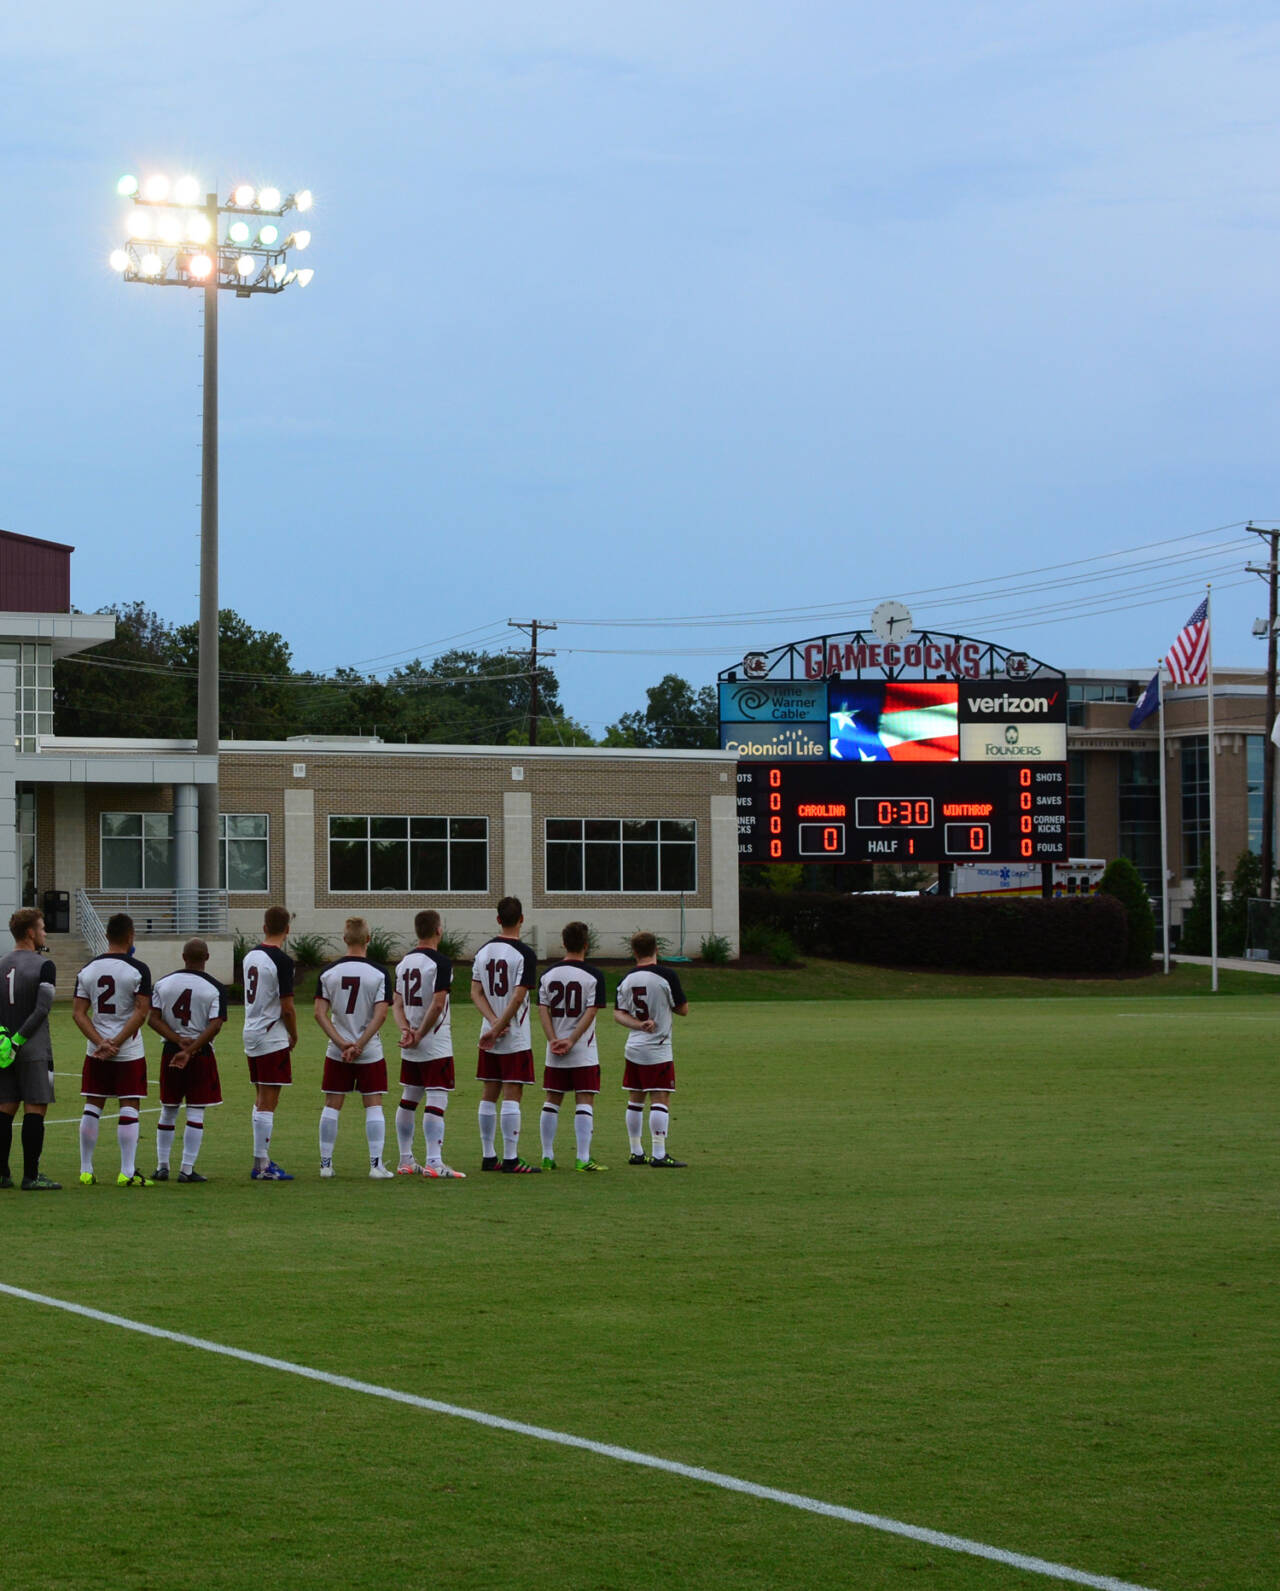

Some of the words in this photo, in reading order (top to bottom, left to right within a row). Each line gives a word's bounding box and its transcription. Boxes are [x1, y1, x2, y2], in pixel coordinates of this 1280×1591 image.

[804, 643, 981, 680] GAMECOCKS
[773, 687, 802, 697] Time
[772, 697, 816, 708] Warner
[968, 693, 1048, 713] verizon
[772, 708, 806, 719] Cable
[725, 741, 793, 755] Colonial
[796, 741, 824, 755] Life
[770, 769, 781, 787] 0
[1020, 768, 1031, 787] 0
[1036, 773, 1062, 782] SHOTS
[770, 793, 781, 811] 0
[943, 804, 993, 816] WINTHROP
[1020, 792, 1031, 810] 0
[1036, 796, 1062, 805] SAVES
[798, 804, 846, 817] CAROLINA
[879, 802, 929, 824] 0:30
[771, 816, 781, 834] 0
[1021, 815, 1032, 833] 0
[1033, 815, 1065, 824] CORNER
[1038, 825, 1061, 833] KICKS
[824, 828, 838, 851] 0
[868, 841, 898, 853] HALF
[909, 839, 914, 855] 1
[970, 827, 984, 850] 0
[1021, 838, 1032, 856] 0
[1037, 843, 1063, 852] FOULS
[771, 840, 782, 857] 0
[6, 967, 17, 1005] 1
[247, 966, 259, 1005] 3
[402, 968, 423, 1006] 12
[486, 959, 509, 997] 13
[97, 975, 116, 1014] 2
[341, 976, 361, 1014] 7
[548, 981, 583, 1018] 20
[632, 986, 650, 1021] 5
[172, 988, 192, 1027] 4
